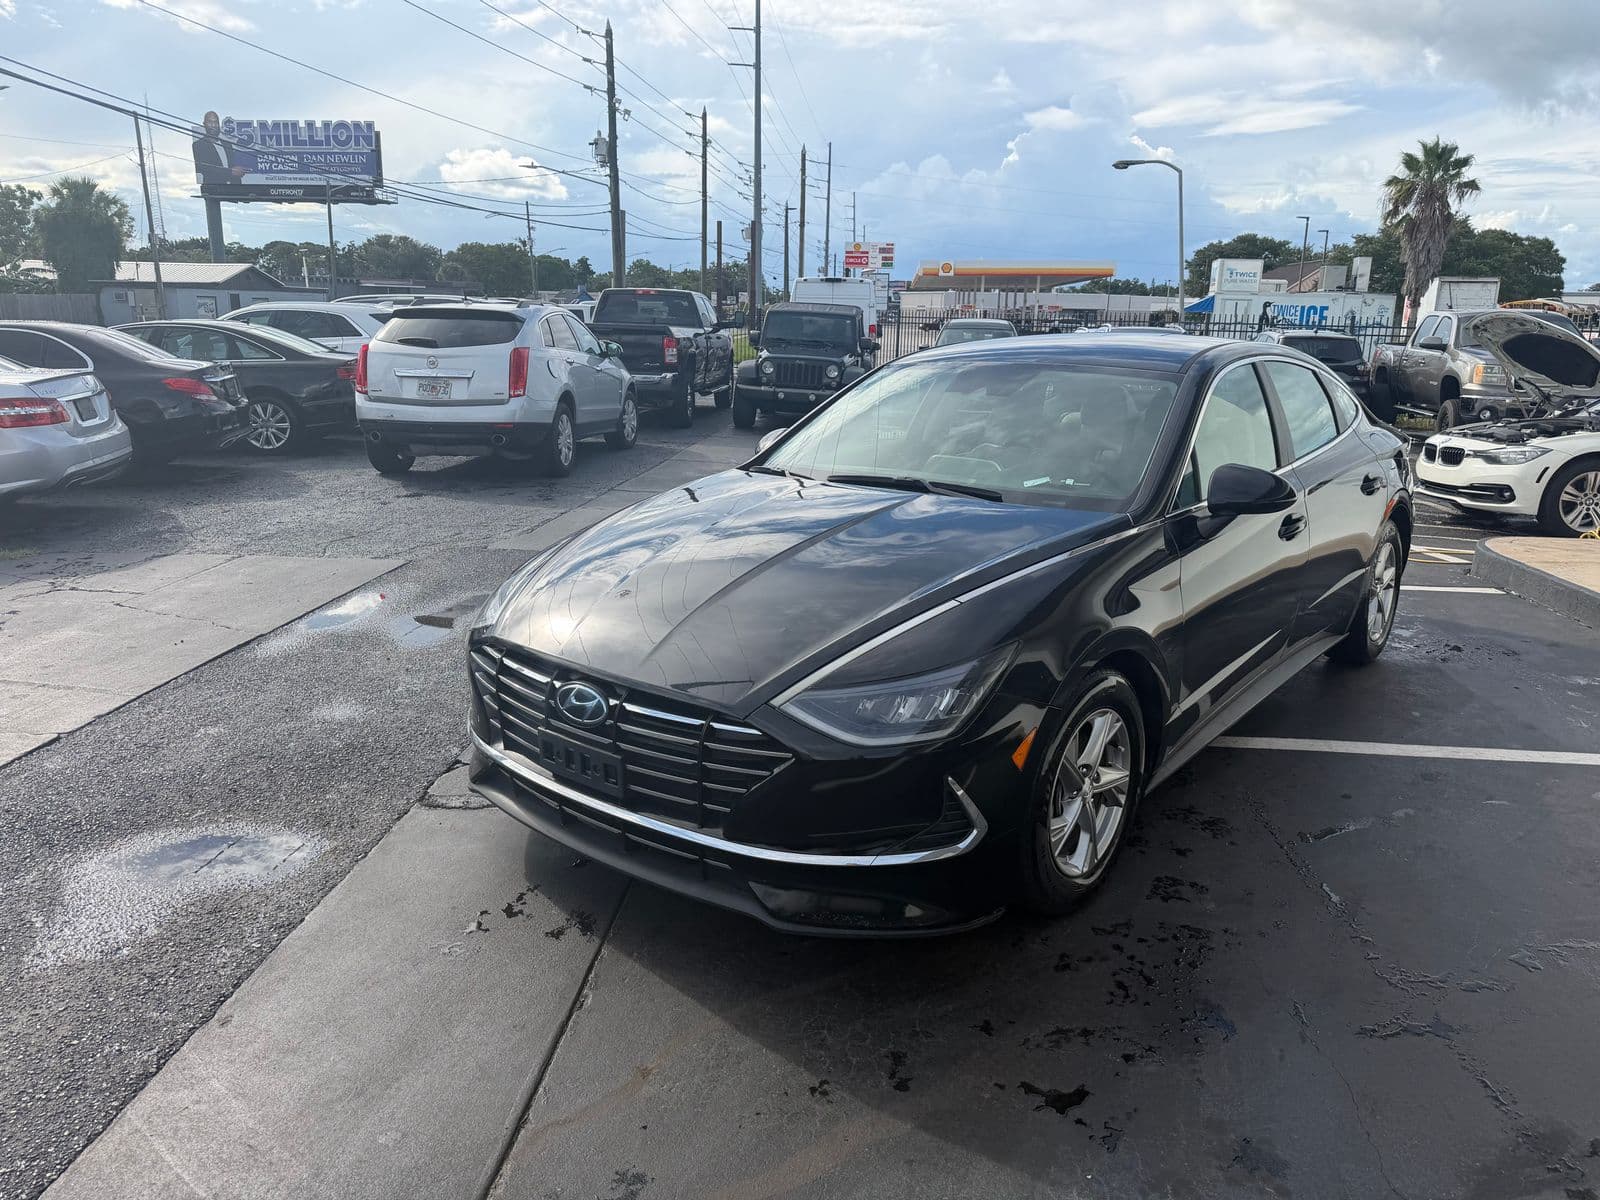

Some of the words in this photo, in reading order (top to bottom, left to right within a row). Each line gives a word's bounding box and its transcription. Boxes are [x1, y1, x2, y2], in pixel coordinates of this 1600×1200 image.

[222, 117, 256, 149] $5
[257, 119, 375, 148] MILLION
[303, 154, 325, 163] DAN
[327, 154, 366, 164] NEWLIN
[1272, 304, 1299, 317] TWICE
[1299, 304, 1329, 326] ICE
